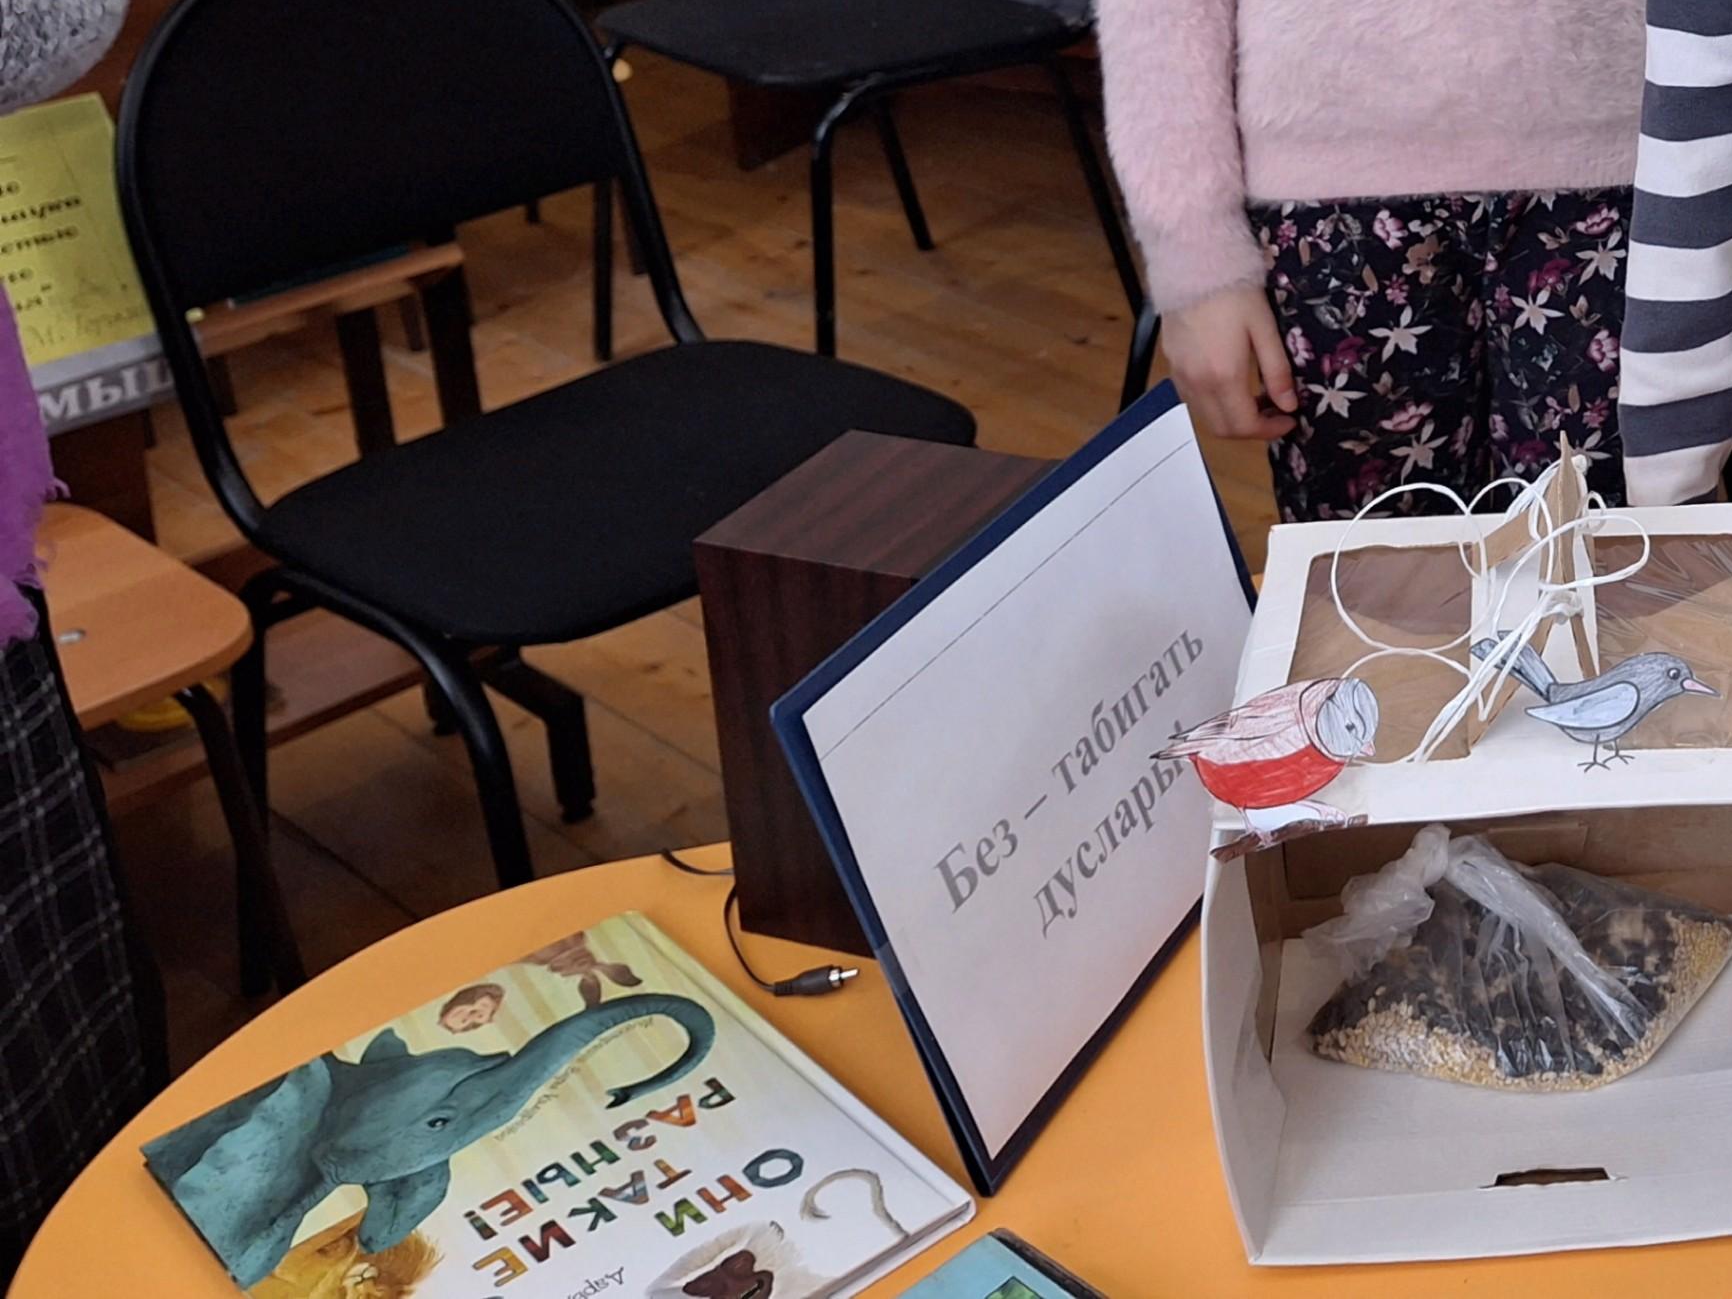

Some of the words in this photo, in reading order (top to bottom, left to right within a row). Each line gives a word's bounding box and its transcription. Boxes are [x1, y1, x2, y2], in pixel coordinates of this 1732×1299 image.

[933, 818, 1019, 914] Без
[1051, 629, 1204, 796] табигать
[463, 1076, 737, 1241] РАЗНЫЕ!
[471, 1158, 692, 1288] ТАКИЕ
[654, 1148, 805, 1238] ОНИ
